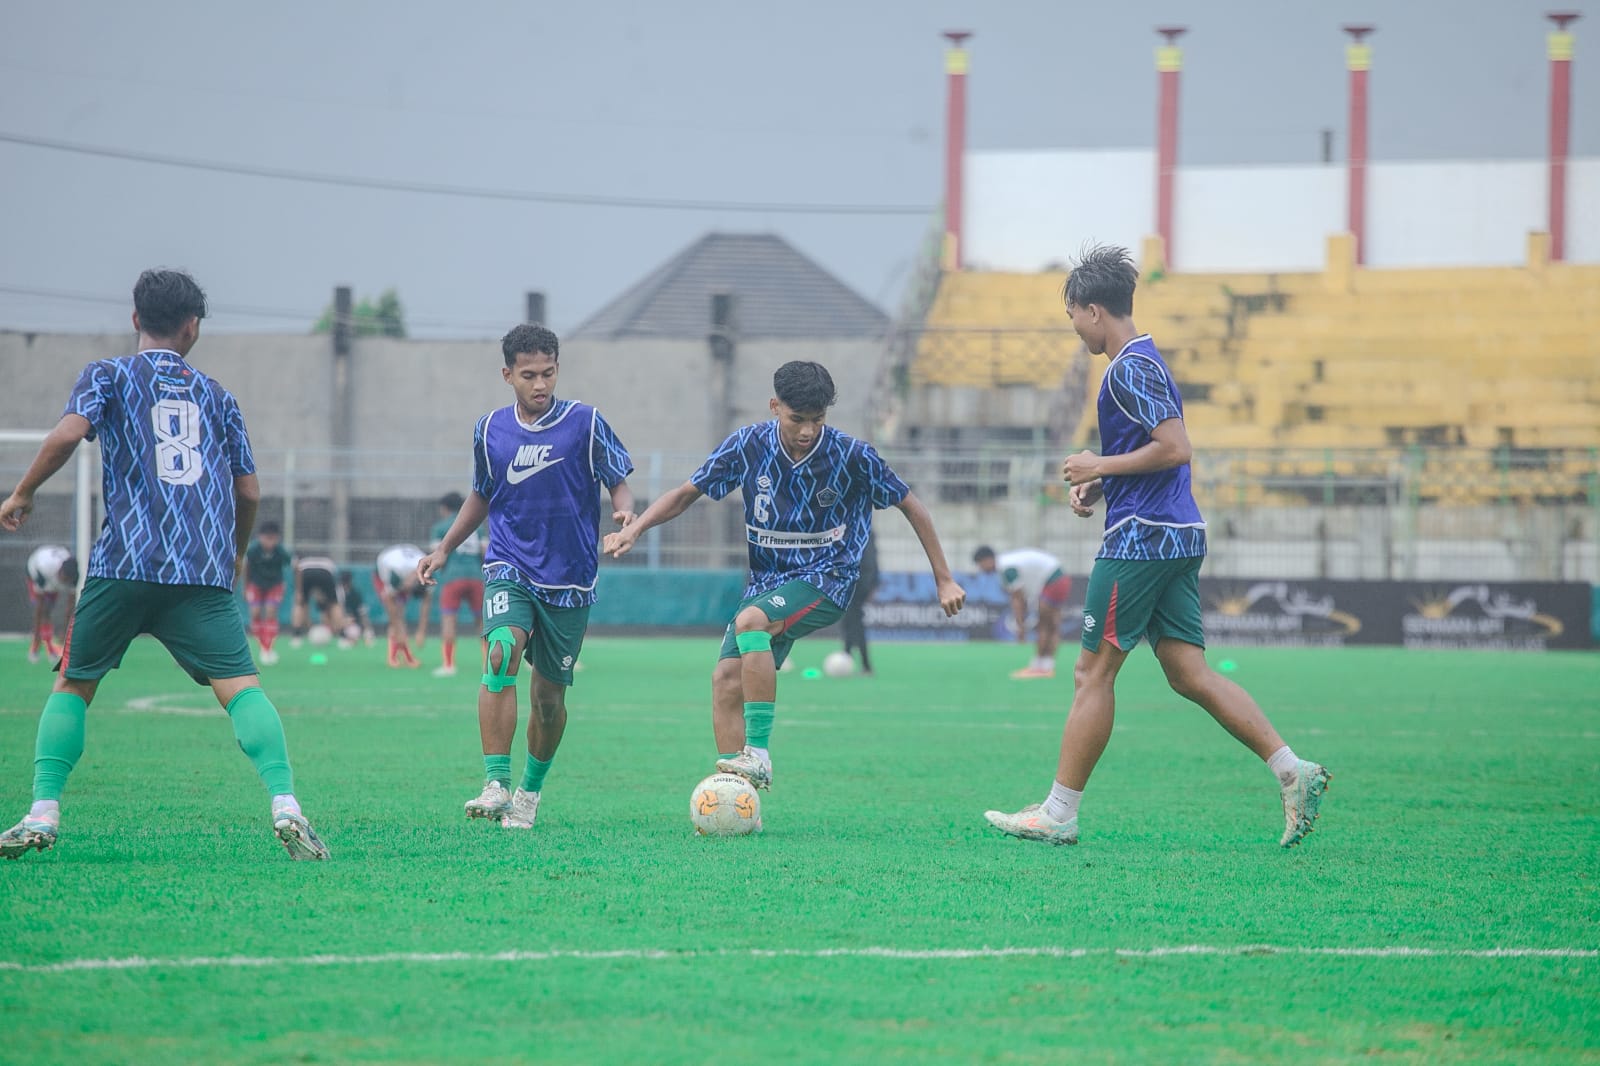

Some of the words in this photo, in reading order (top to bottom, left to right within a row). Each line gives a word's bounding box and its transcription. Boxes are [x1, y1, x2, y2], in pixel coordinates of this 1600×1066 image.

[151, 399, 203, 486] 8
[513, 444, 553, 467] NIKE
[754, 494, 770, 522] 6
[760, 535, 769, 545] PT
[486, 591, 509, 619] 18
